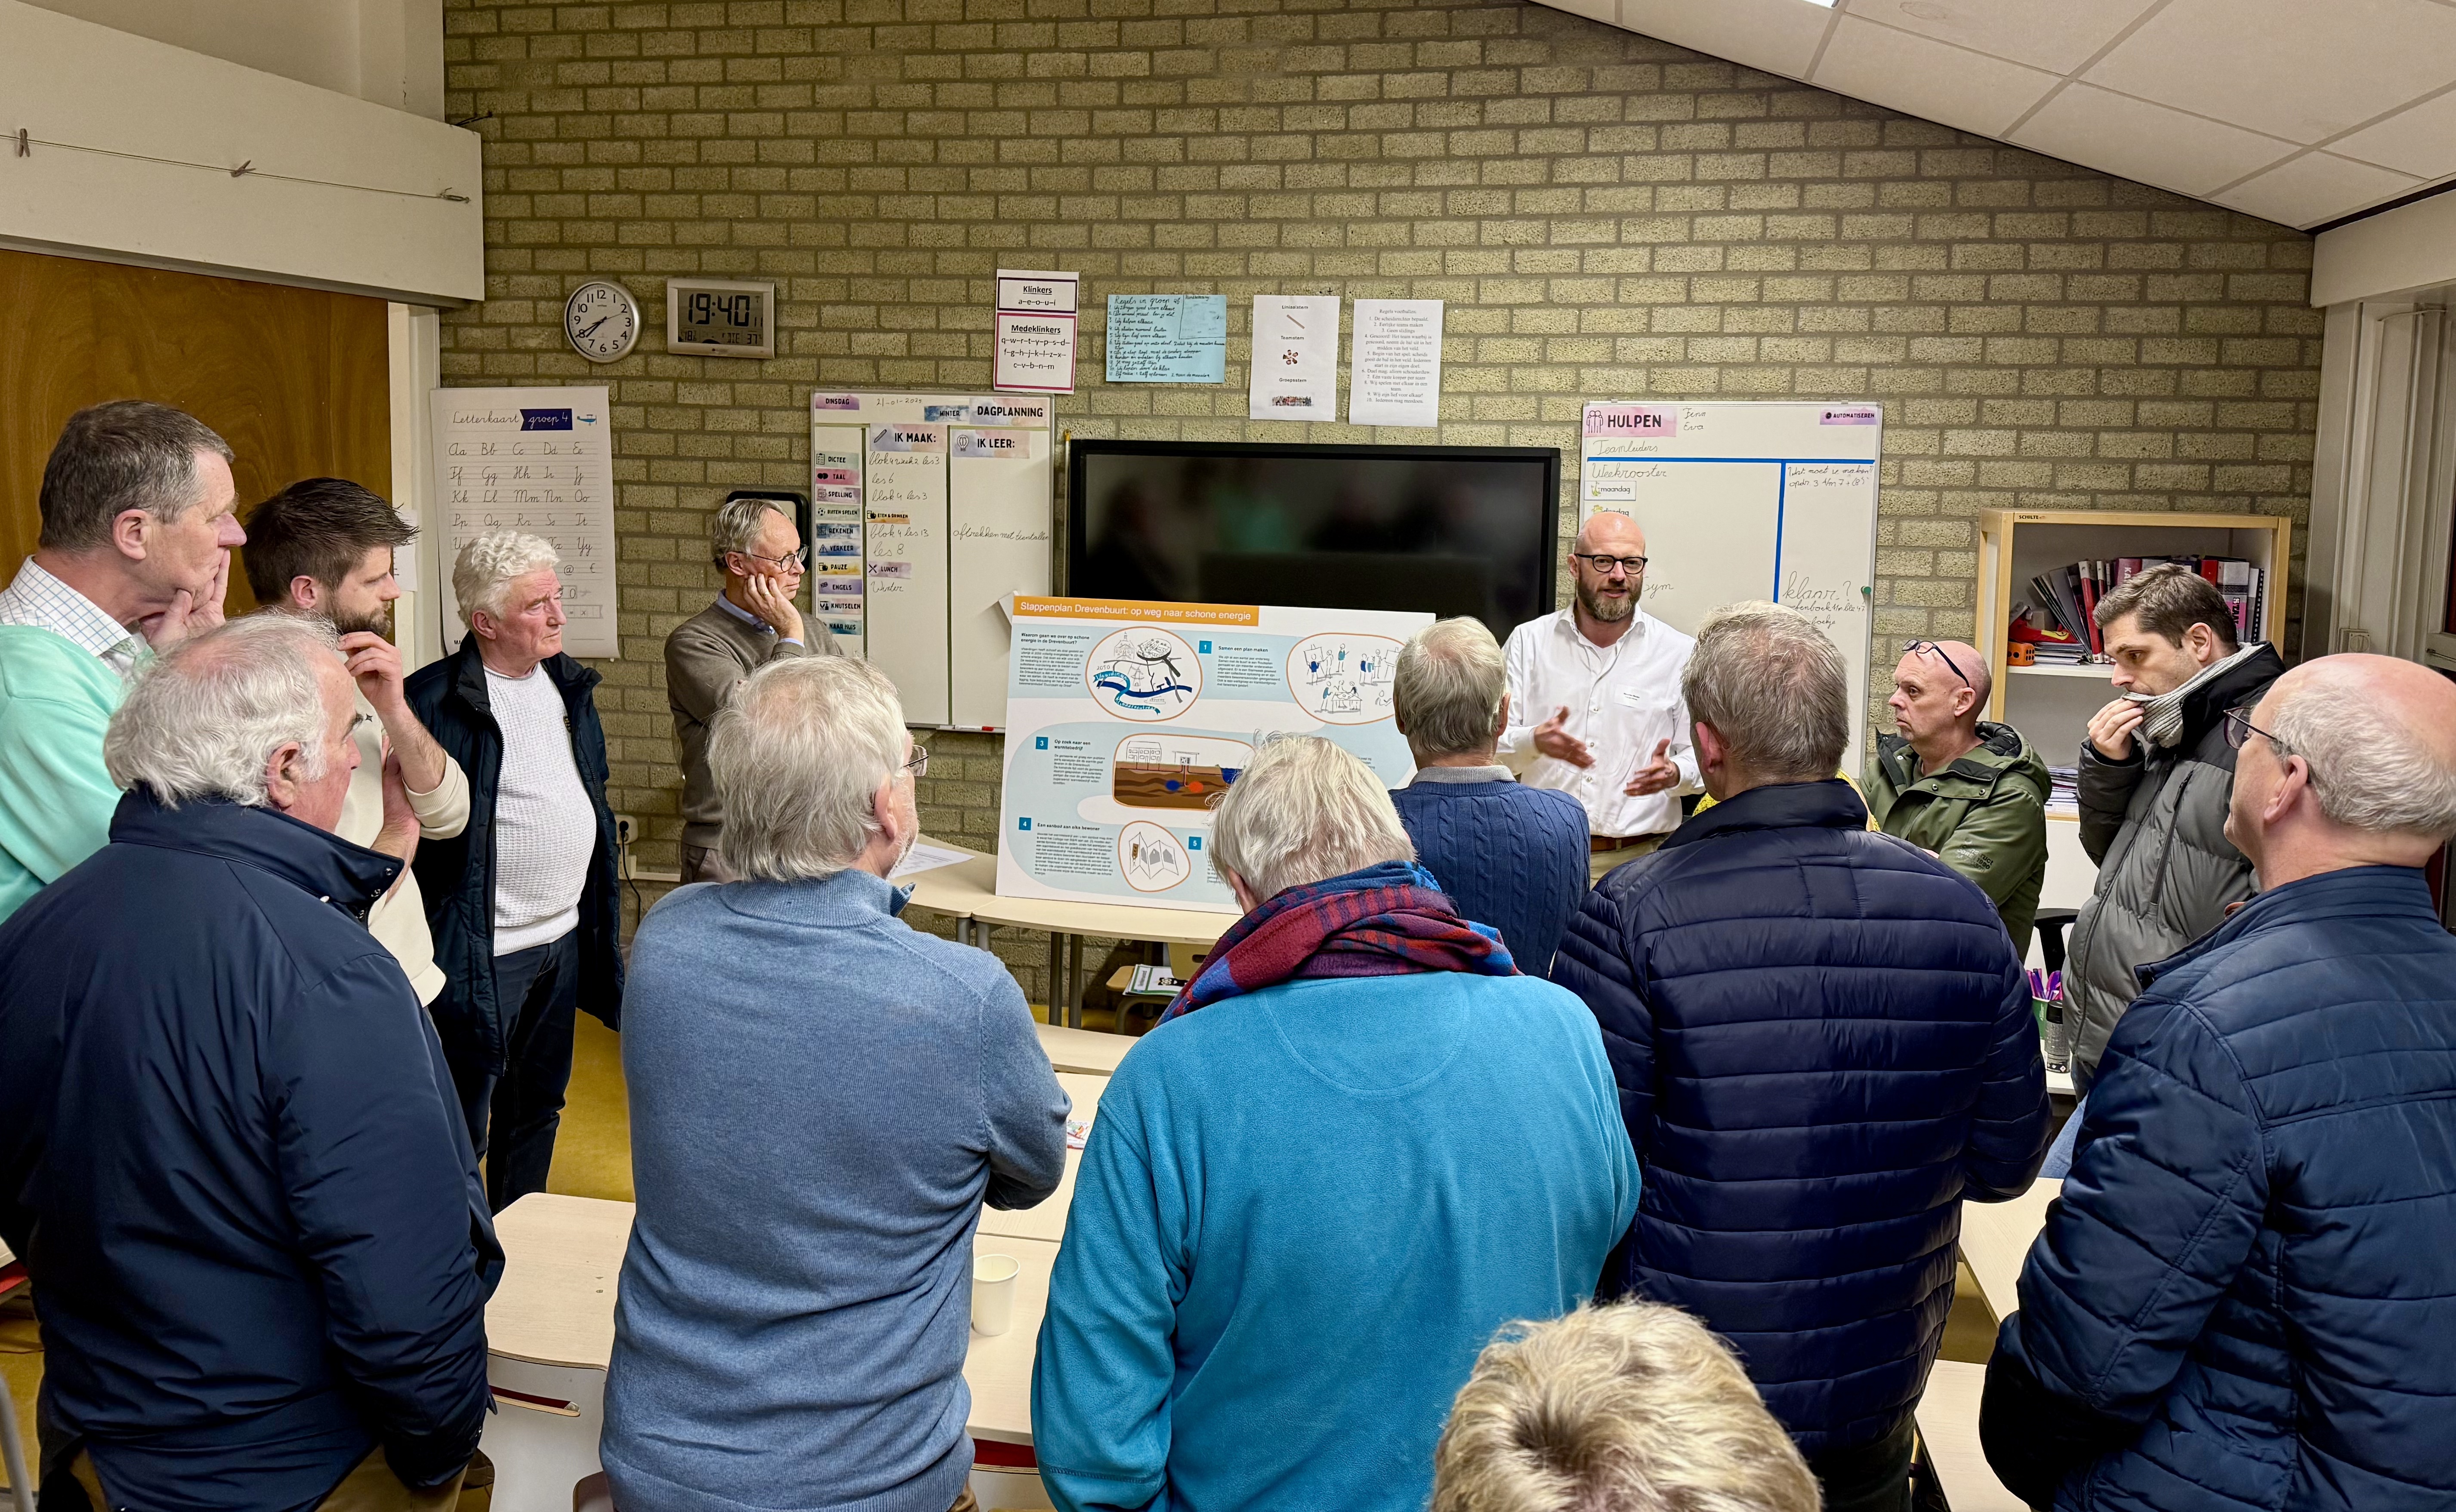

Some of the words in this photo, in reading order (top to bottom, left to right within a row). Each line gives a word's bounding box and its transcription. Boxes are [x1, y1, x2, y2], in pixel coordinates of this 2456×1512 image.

[587, 294, 593, 303] 11
[597, 290, 606, 299] 12
[613, 294, 616, 302] 1
[578, 304, 587, 313] 10
[621, 304, 627, 313] 2
[688, 293, 750, 326] 19:40
[574, 316, 580, 324] 9
[625, 318, 631, 327] 3
[620, 331, 627, 339] 4
[589, 339, 595, 348] 7
[600, 344, 606, 352] 6
[613, 340, 618, 349] 5
[978, 406, 1043, 417] DAGPLANNING
[454, 411, 519, 423] Letterkaart
[528, 417, 559, 429] groep
[562, 412, 568, 422] 4
[1608, 415, 1661, 428] HULPEN
[895, 434, 904, 442] IK
[907, 434, 936, 443] MAAK:
[978, 439, 986, 447] IK
[990, 439, 1015, 448] LEER:
[449, 443, 466, 455] Aa
[481, 443, 497, 455] Bb
[512, 442, 524, 455] Cc
[544, 442, 558, 454] Dd
[573, 442, 583, 454] Ee
[1592, 463, 1667, 478] Weekrooster
[482, 466, 498, 486] Gg
[513, 466, 530, 478] Hh
[889, 473, 894, 483] 6
[452, 490, 468, 503] Kk
[484, 490, 497, 503] Ll
[514, 490, 540, 503] Mm
[544, 490, 563, 502] Nn
[575, 489, 589, 502] Oo
[452, 513, 468, 530] Pp
[484, 513, 502, 529] Qq
[516, 513, 531, 526] Rr
[545, 513, 555, 526] Ss
[576, 513, 588, 526] Tt
[577, 537, 592, 556] Yy
[897, 544, 904, 554] 8
[1021, 602, 1072, 613] Stappenplan
[1075, 605, 1128, 615] Drevenbuurt:
[1144, 609, 1161, 618] weg
[1186, 609, 1216, 619] schone
[1219, 611, 1251, 621] energie
